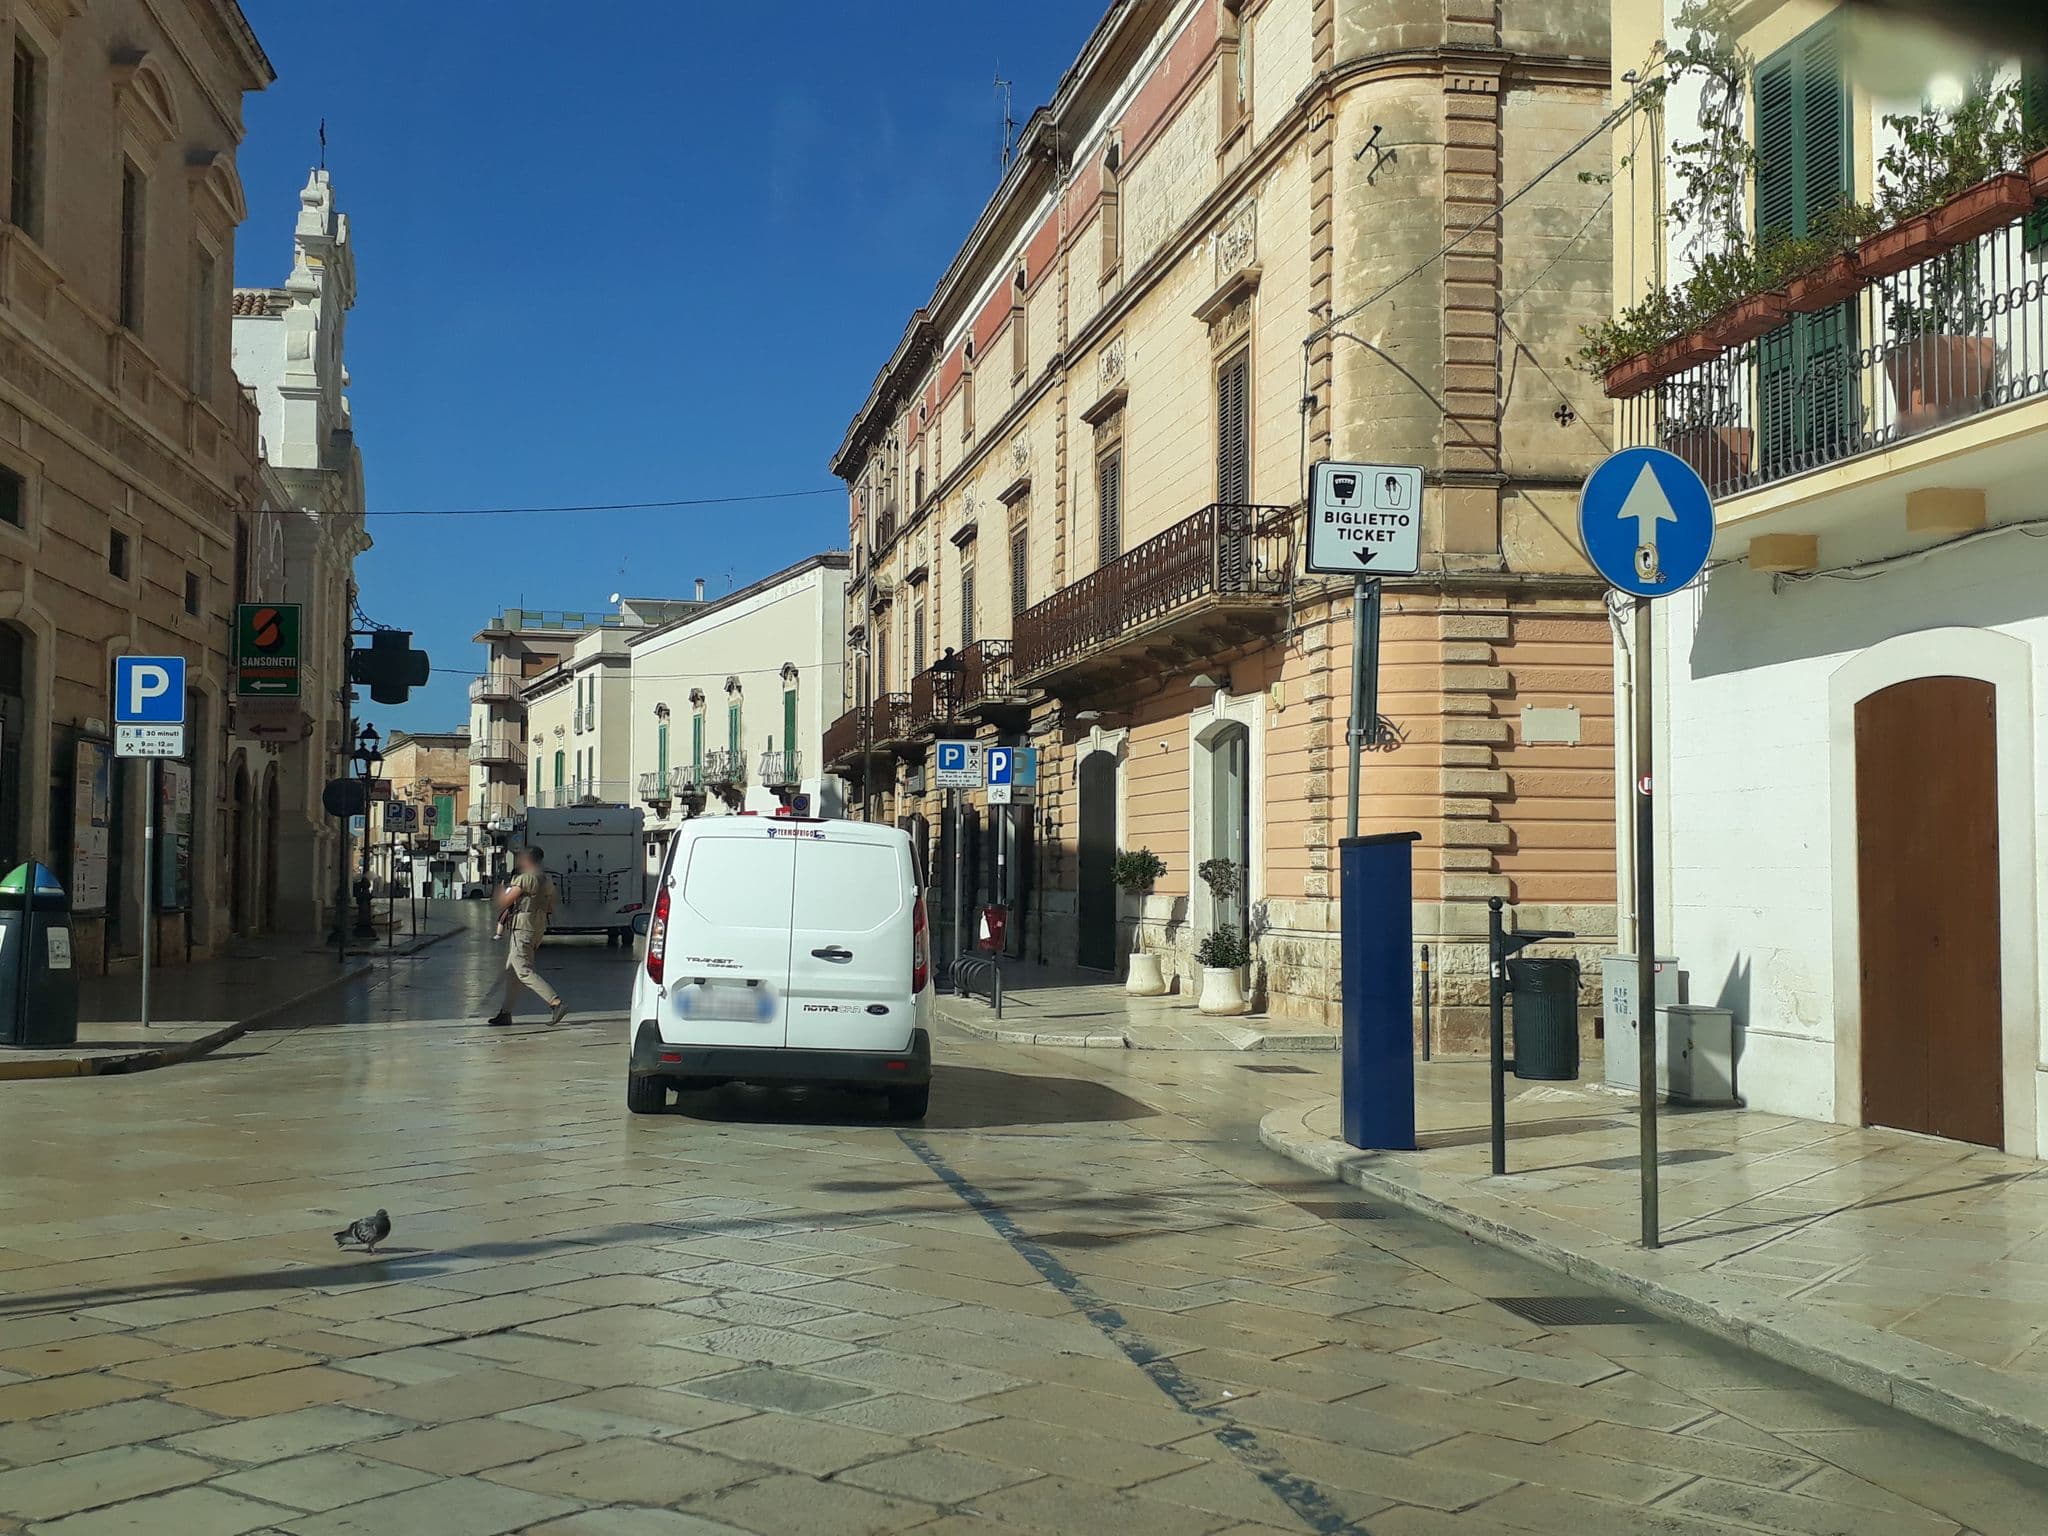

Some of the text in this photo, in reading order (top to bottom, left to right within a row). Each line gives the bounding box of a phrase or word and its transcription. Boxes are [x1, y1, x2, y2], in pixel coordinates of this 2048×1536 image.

[1324, 511, 1410, 527] BIGLIETTO
[1337, 528, 1396, 542] TICKET
[241, 657, 296, 667] SANSONETTI
[130, 665, 170, 714] P
[945, 748, 959, 766] P
[992, 751, 1007, 781] P
[777, 828, 814, 837] TERMOFRIGO
[686, 956, 734, 964] TRANSIT
